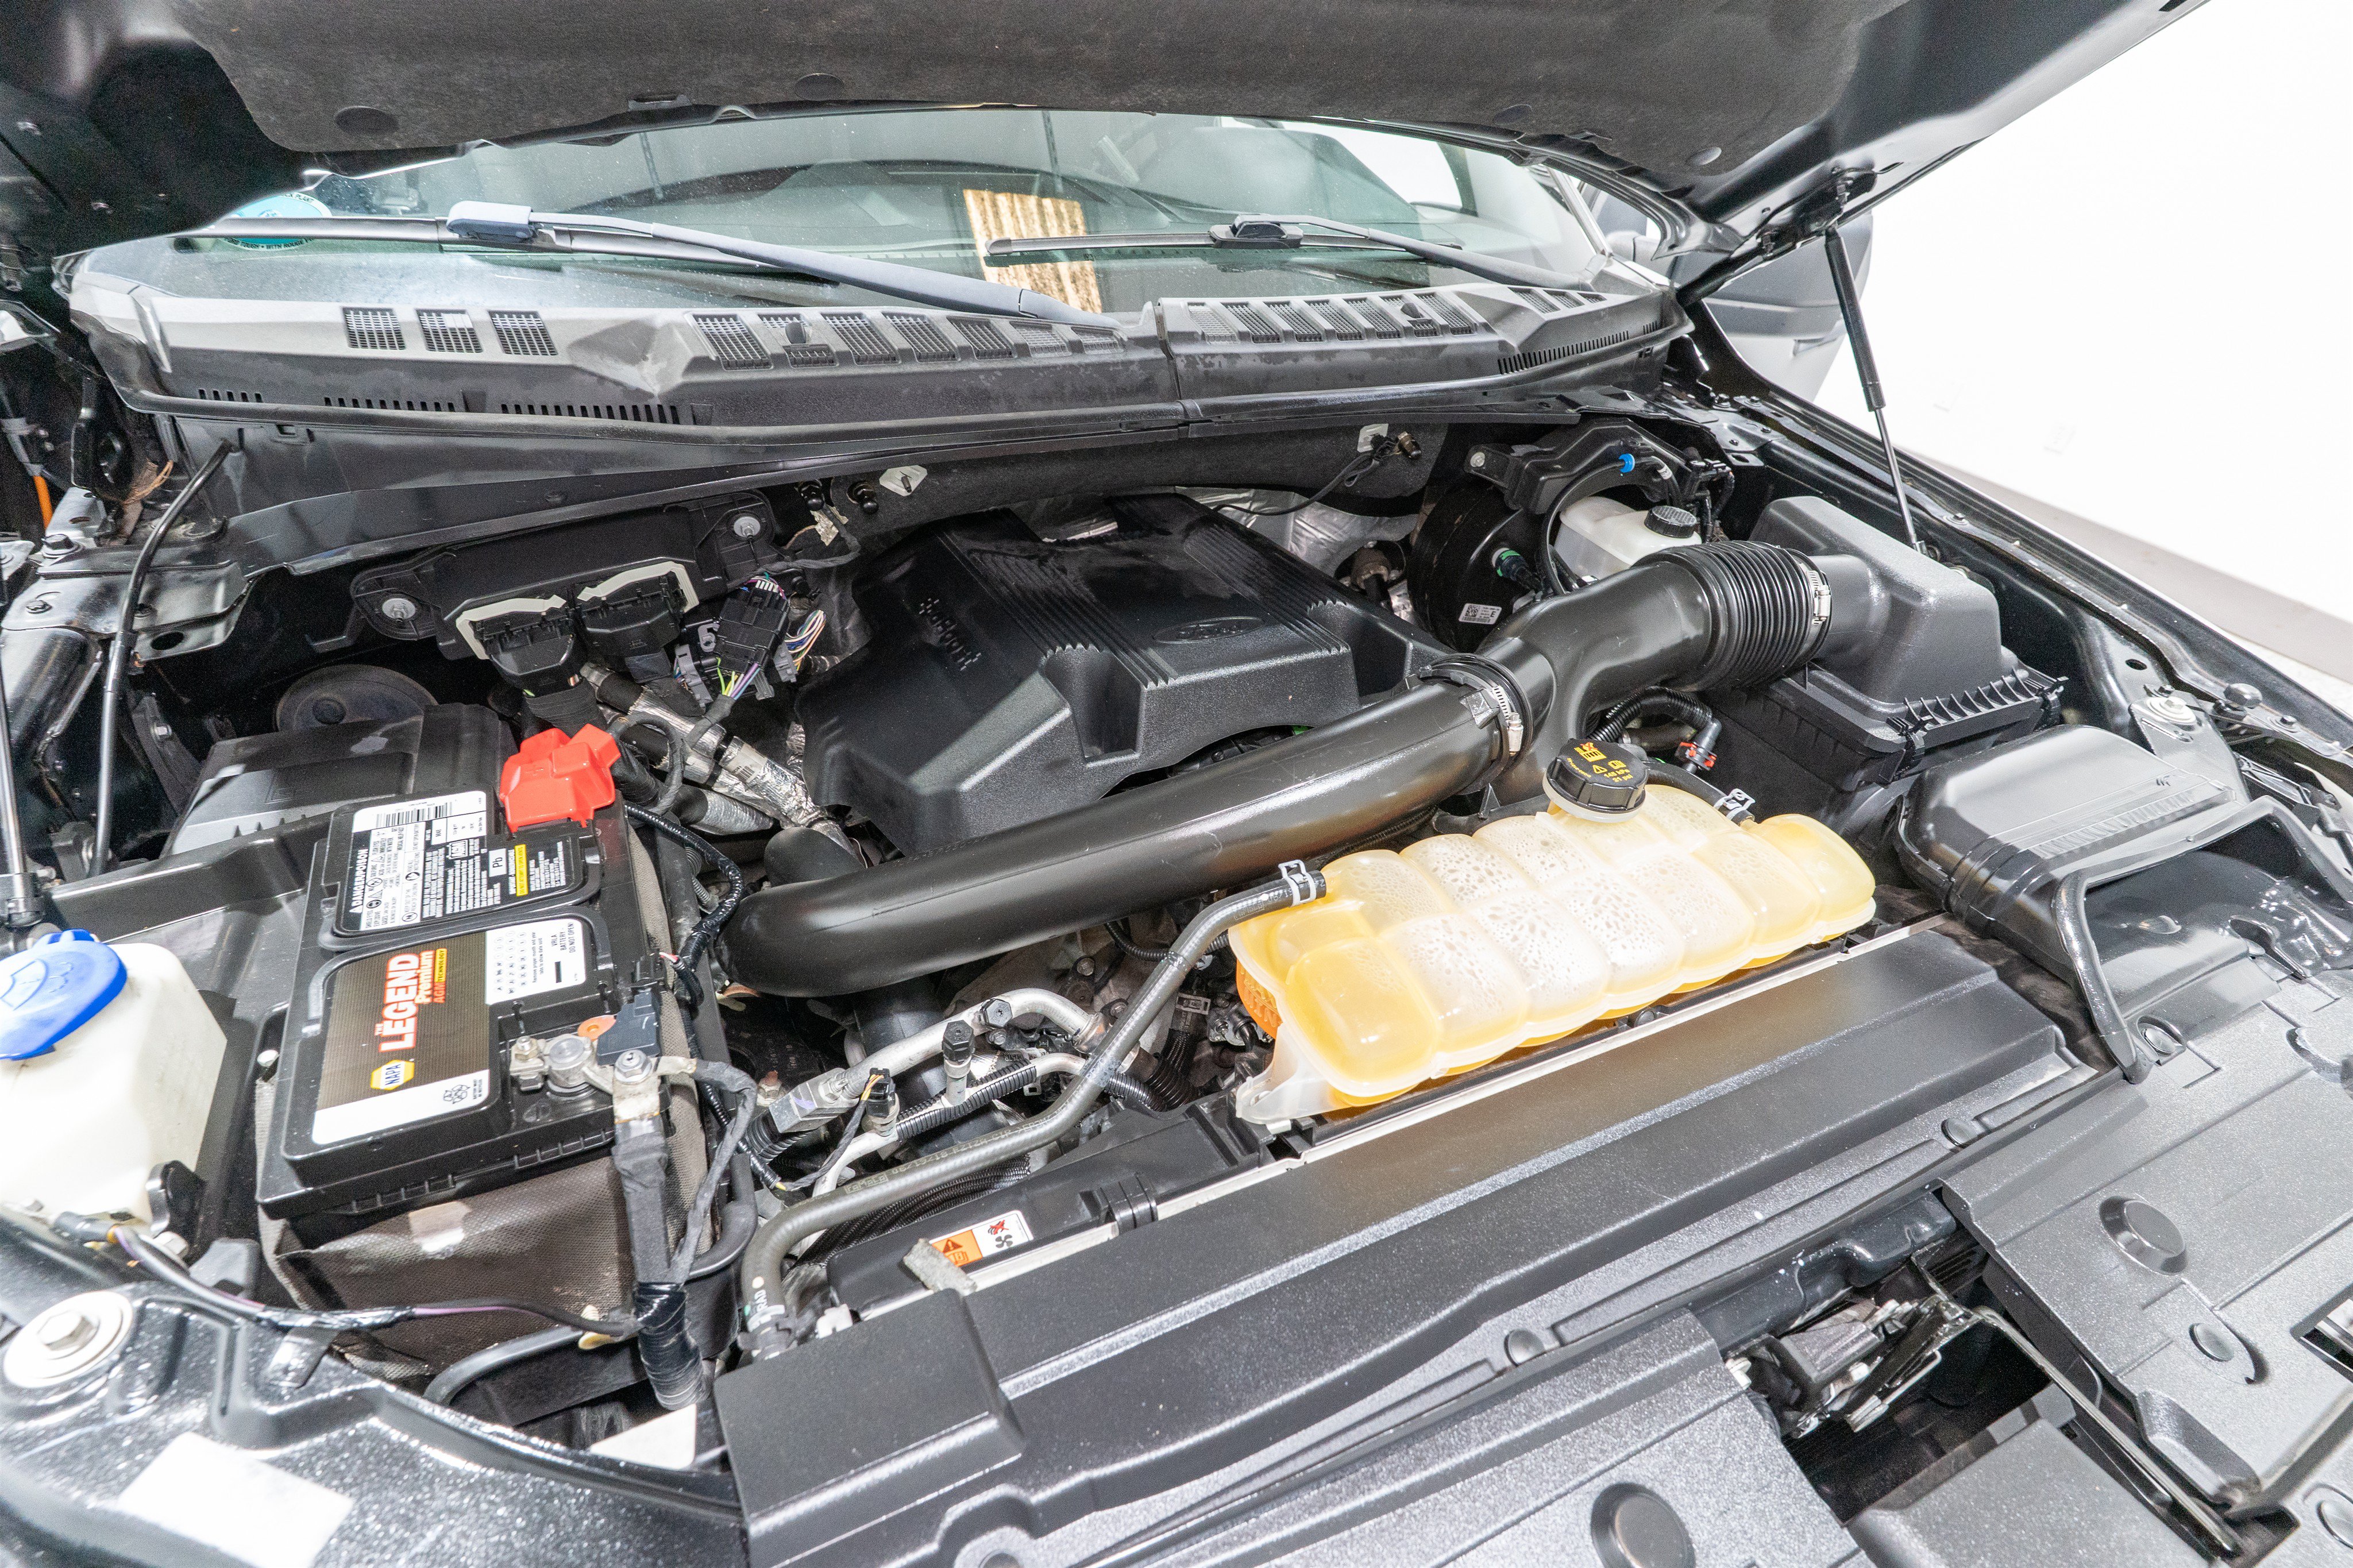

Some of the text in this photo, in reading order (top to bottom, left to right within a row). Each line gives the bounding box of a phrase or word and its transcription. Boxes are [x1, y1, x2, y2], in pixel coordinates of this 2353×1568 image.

[492, 857, 503, 868] Pb
[352, 849, 368, 906] DANGER/POISON
[414, 950, 435, 1003] Premium
[379, 953, 419, 1052] LEGEND
[434, 982, 445, 1003] AGM
[375, 1023, 384, 1036] THE
[385, 1064, 401, 1086] NAPA
